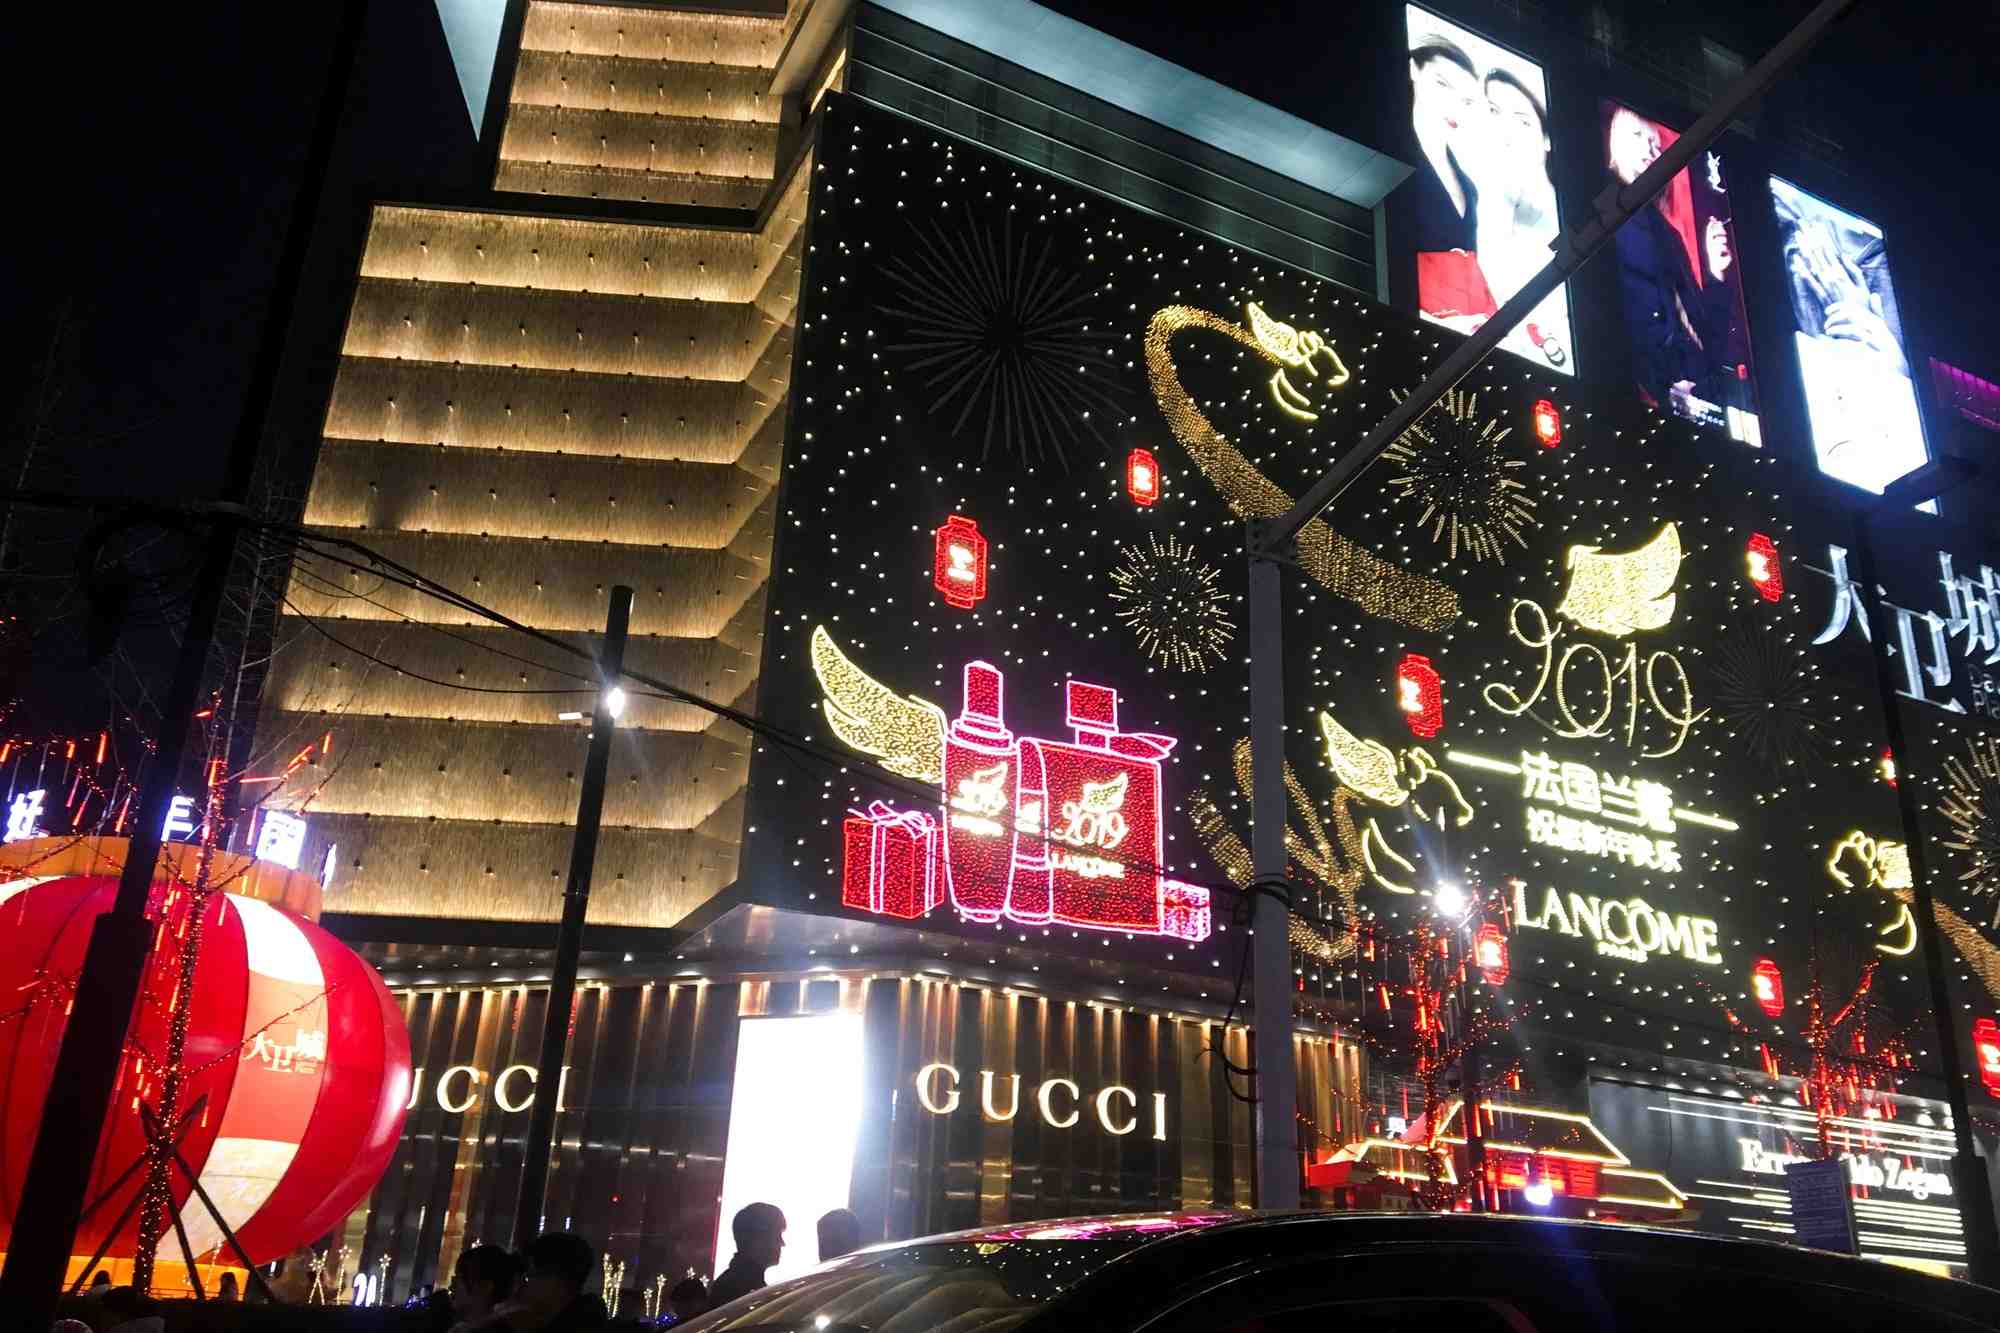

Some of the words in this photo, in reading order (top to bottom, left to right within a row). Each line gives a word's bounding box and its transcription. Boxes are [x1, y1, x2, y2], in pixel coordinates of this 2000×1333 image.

[1483, 599, 1711, 759] 2019
[1050, 801, 1130, 849] 2019
[916, 1063, 1167, 1141] GUCCI
